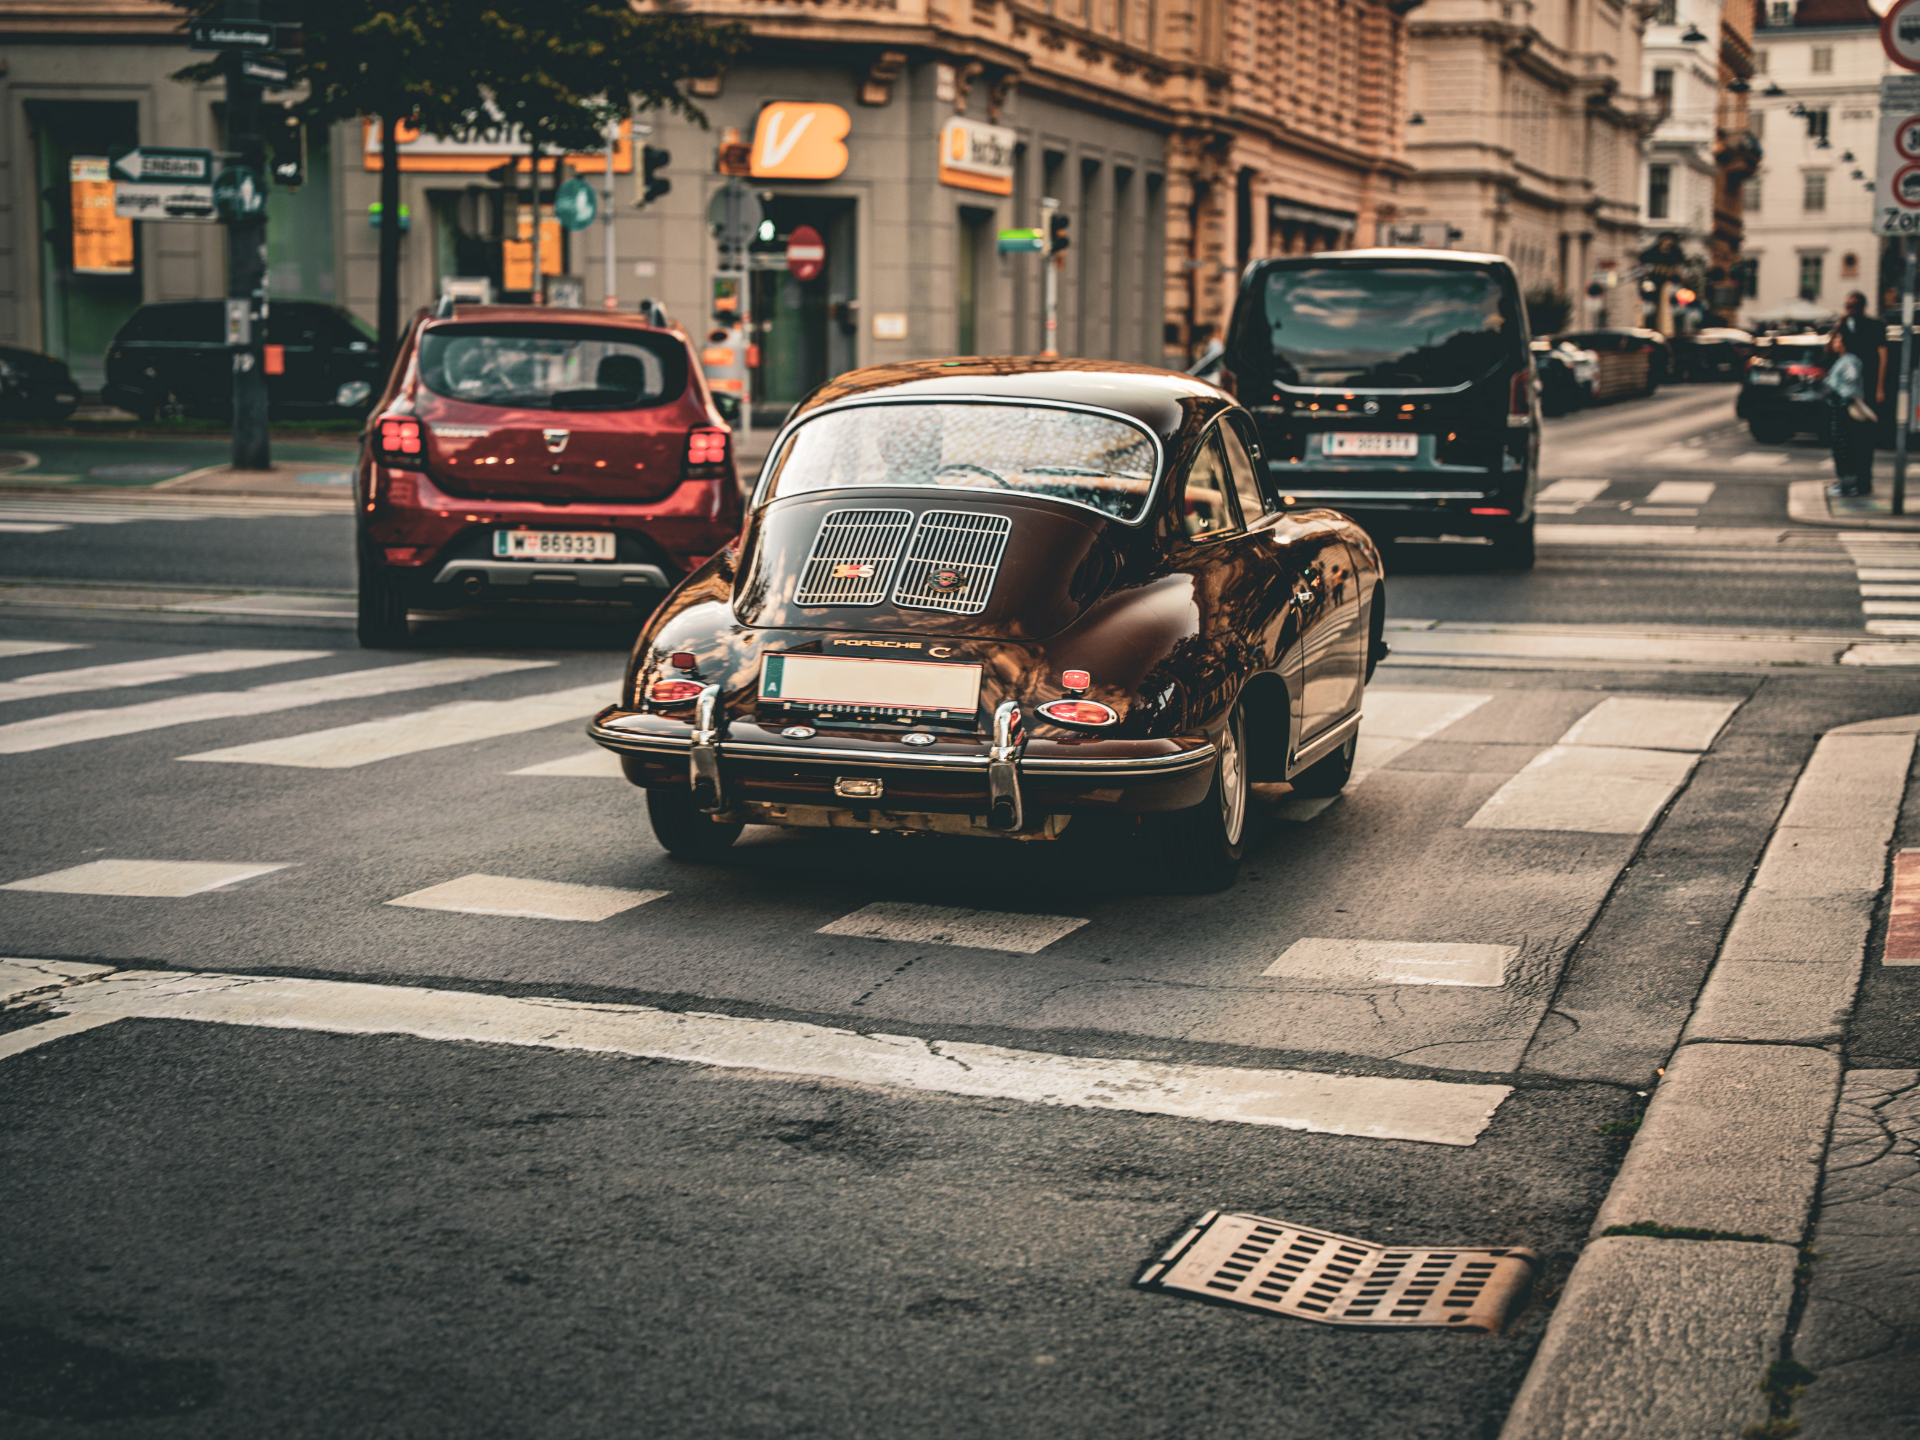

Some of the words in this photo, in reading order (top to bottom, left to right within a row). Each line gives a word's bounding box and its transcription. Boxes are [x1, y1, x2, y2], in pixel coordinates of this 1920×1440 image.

[513, 535, 527, 551] W
[833, 639, 923, 649] PORSCHE
[928, 646, 952, 659] C
[767, 681, 778, 692] A
